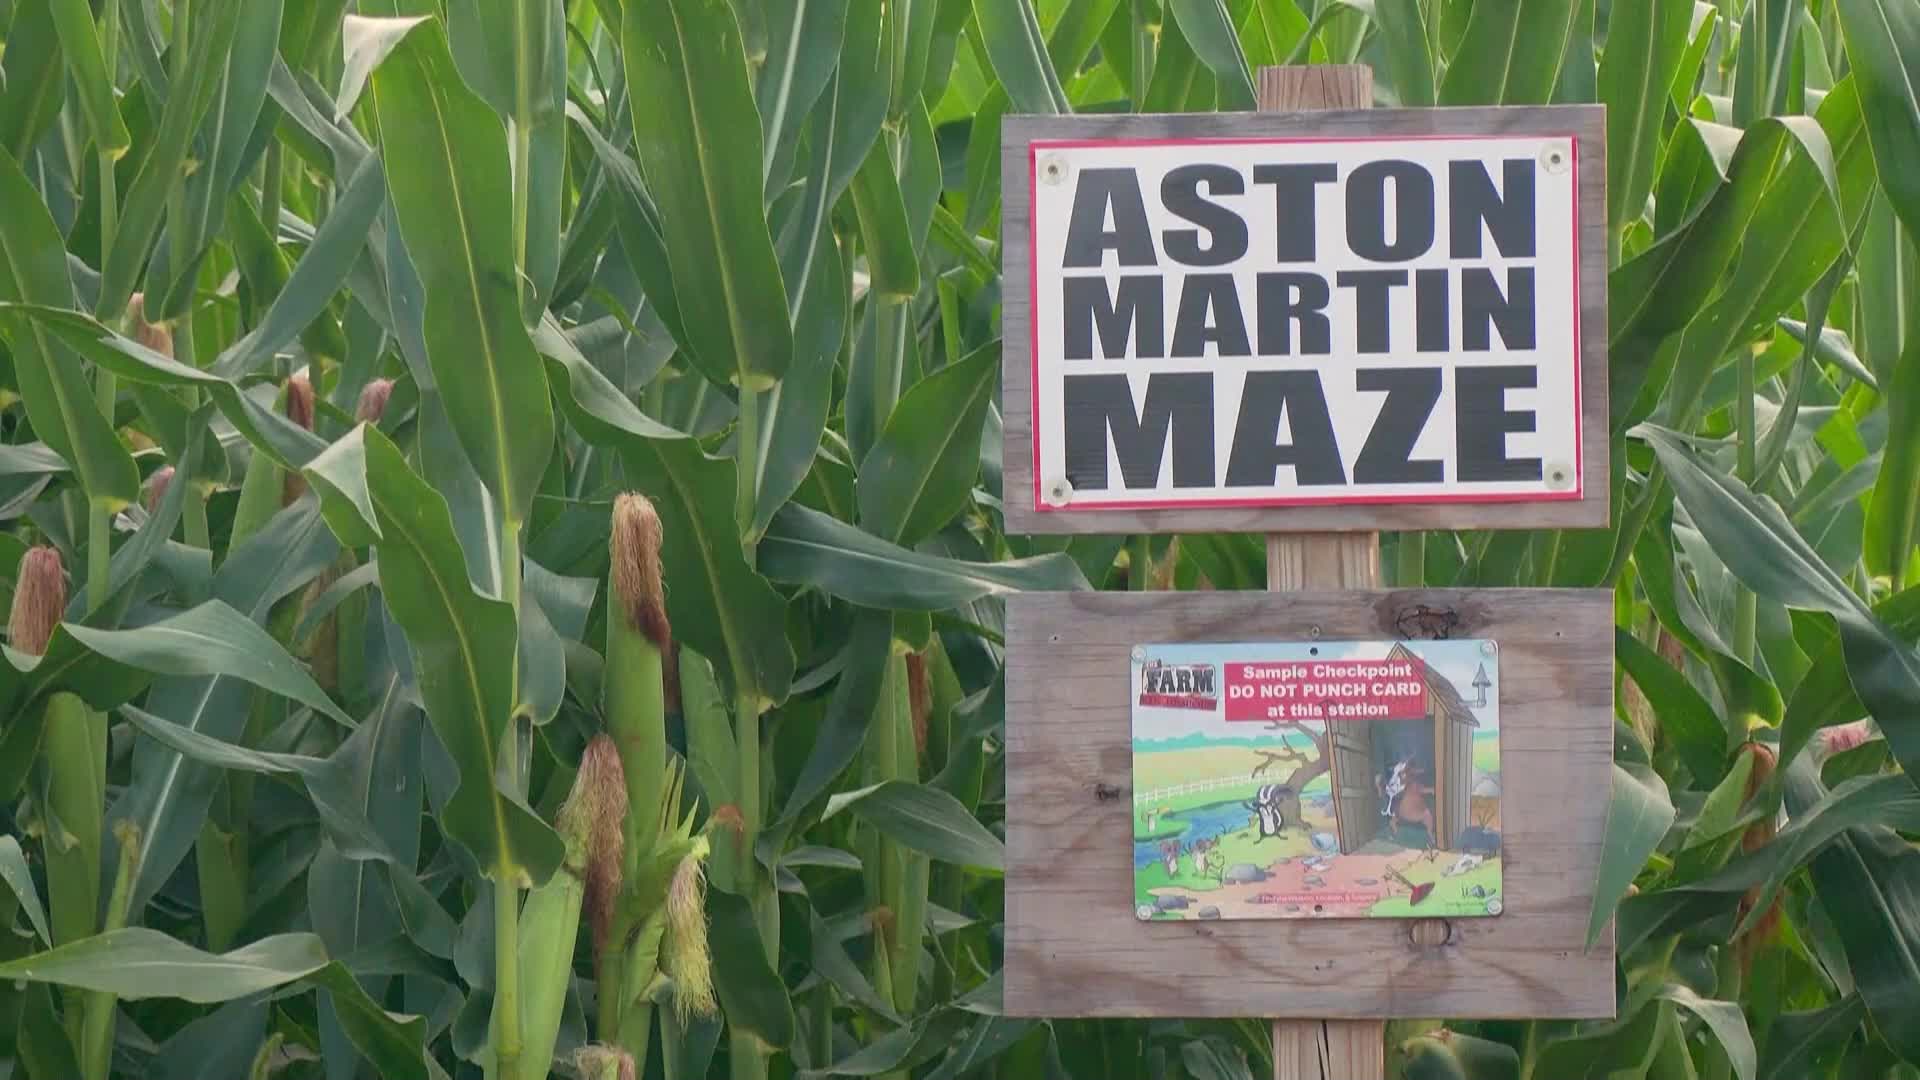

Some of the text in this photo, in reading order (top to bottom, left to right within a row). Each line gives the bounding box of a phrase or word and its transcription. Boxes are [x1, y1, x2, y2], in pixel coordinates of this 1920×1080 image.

[1063, 160, 1535, 267] ASTON
[1063, 267, 1537, 359] MARTIN
[1064, 366, 1542, 490] MAZE
[1146, 667, 1214, 693] FARM
[1243, 663, 1412, 681] Sample Checkpoint
[1230, 682, 1421, 698] DO NOT PUNCH CARD
[1268, 703, 1389, 717] at this station
